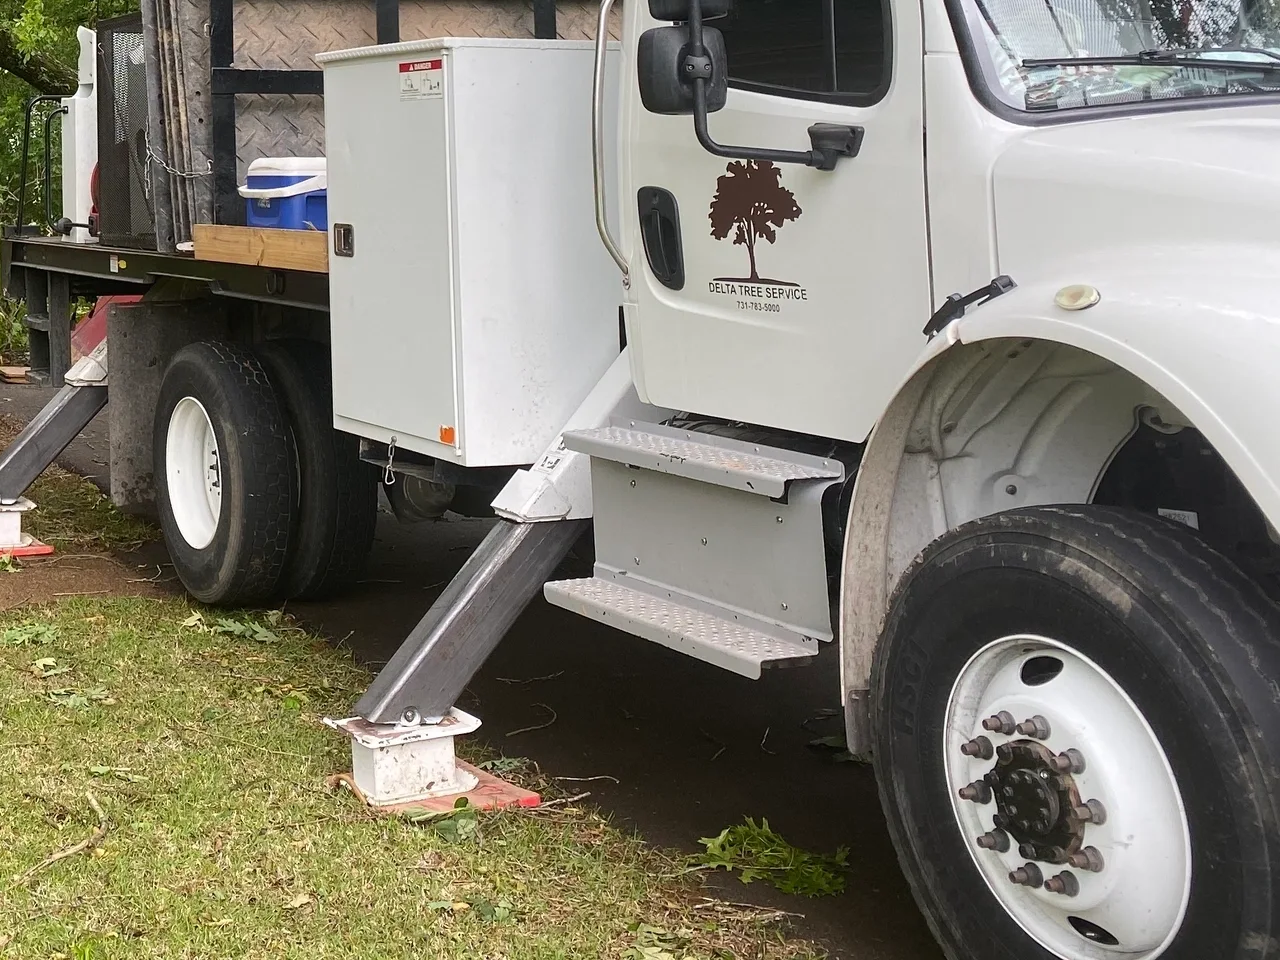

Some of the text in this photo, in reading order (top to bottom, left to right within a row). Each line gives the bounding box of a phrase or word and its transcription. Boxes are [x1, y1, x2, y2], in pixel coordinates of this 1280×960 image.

[414, 62, 432, 70] DANGER
[708, 282, 808, 300] DELTA TREE SERVICE
